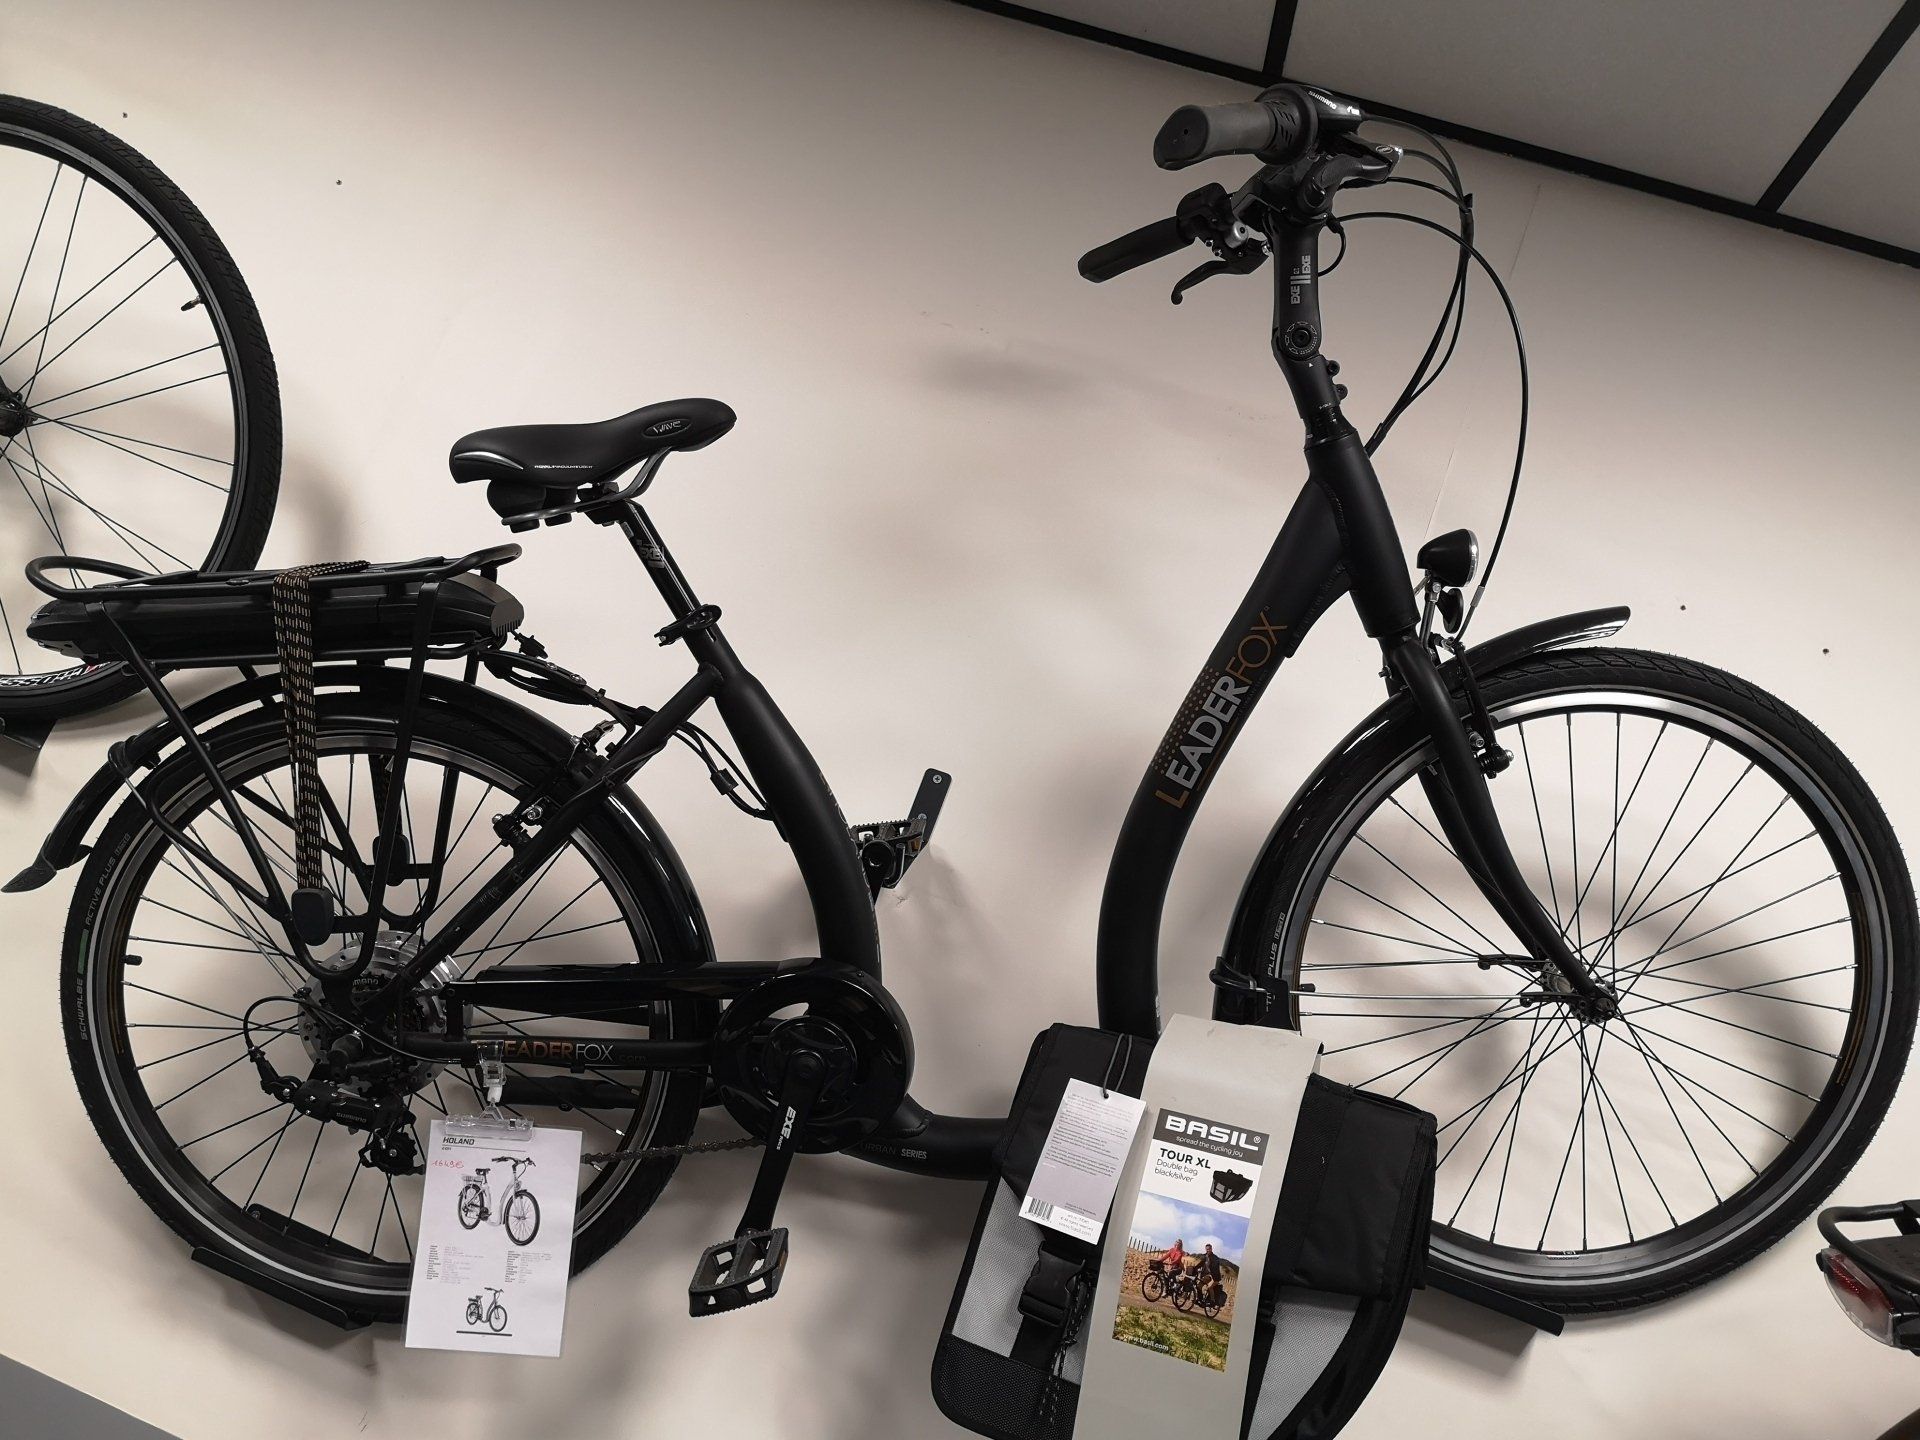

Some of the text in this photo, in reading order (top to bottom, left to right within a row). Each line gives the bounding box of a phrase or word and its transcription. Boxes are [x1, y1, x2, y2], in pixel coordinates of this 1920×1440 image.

[1308, 90, 1337, 110] SHIMANO
[1154, 611, 1288, 809] LEADERFOX
[76, 857, 117, 1041] SCHWALBE ACTIVE PLUS
[1268, 943, 1278, 977] PLUS
[494, 1039, 615, 1062] EADERFOX
[780, 1105, 797, 1139] EXE
[442, 1136, 475, 1146] HOLAND
[1175, 1135, 1244, 1158] spread the cycling joy
[901, 1148, 928, 1160] SERIES
[1160, 1147, 1212, 1169] TOUR XL
[1154, 1167, 1195, 1183] black/silver
[1156, 1158, 1198, 1176] Double bag
